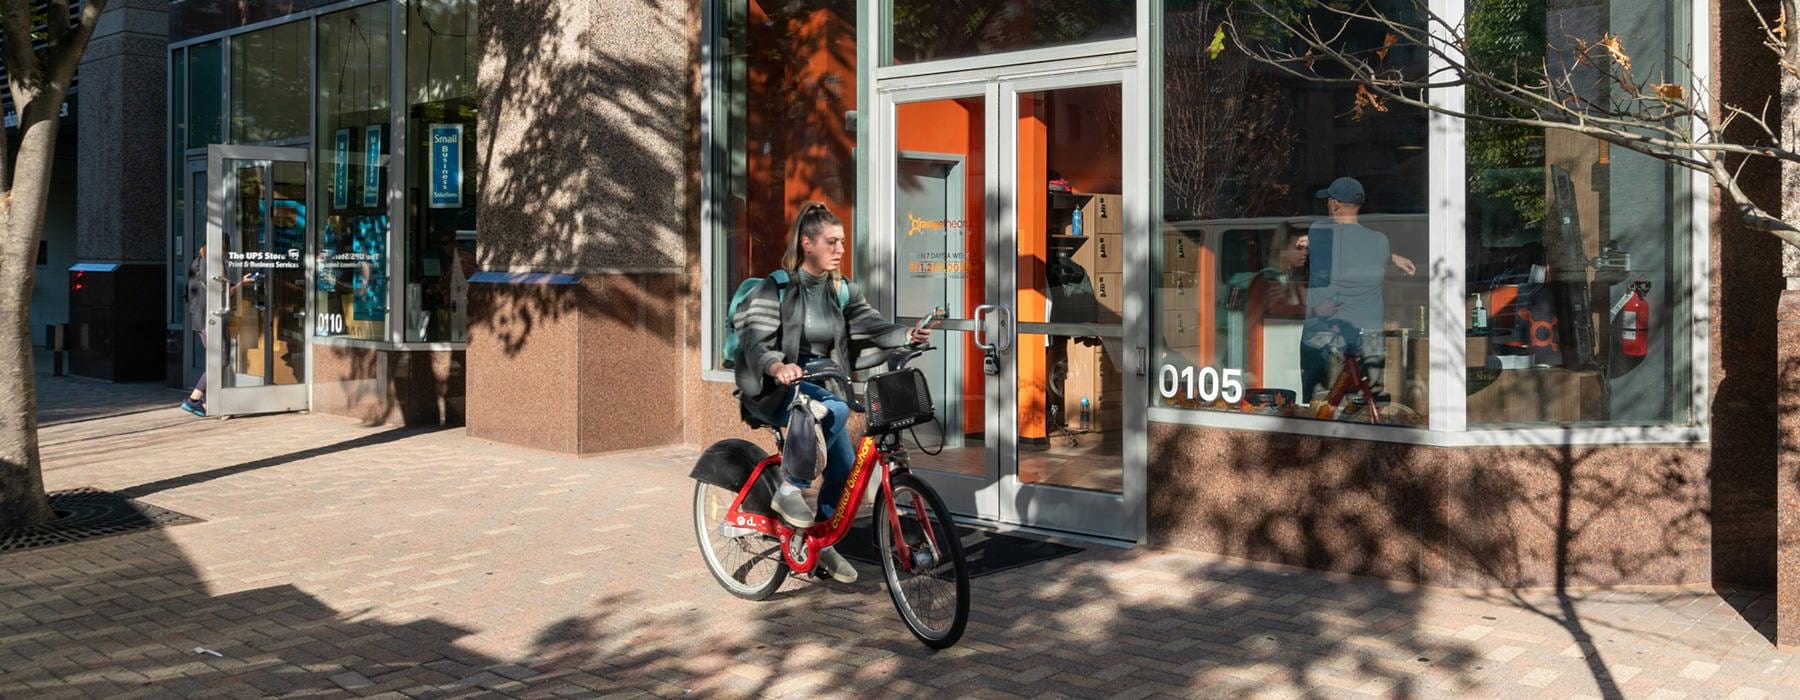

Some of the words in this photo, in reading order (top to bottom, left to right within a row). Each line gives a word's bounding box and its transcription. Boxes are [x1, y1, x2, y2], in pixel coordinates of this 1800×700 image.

[434, 134, 457, 143] Small
[441, 145, 449, 190] Business
[228, 252, 244, 260] The
[245, 252, 263, 260] UPS
[264, 252, 286, 260] Store
[317, 312, 342, 333] 0110
[1159, 363, 1242, 404] 0105
[832, 490, 851, 529] capital
[848, 436, 872, 489] bikeshare
